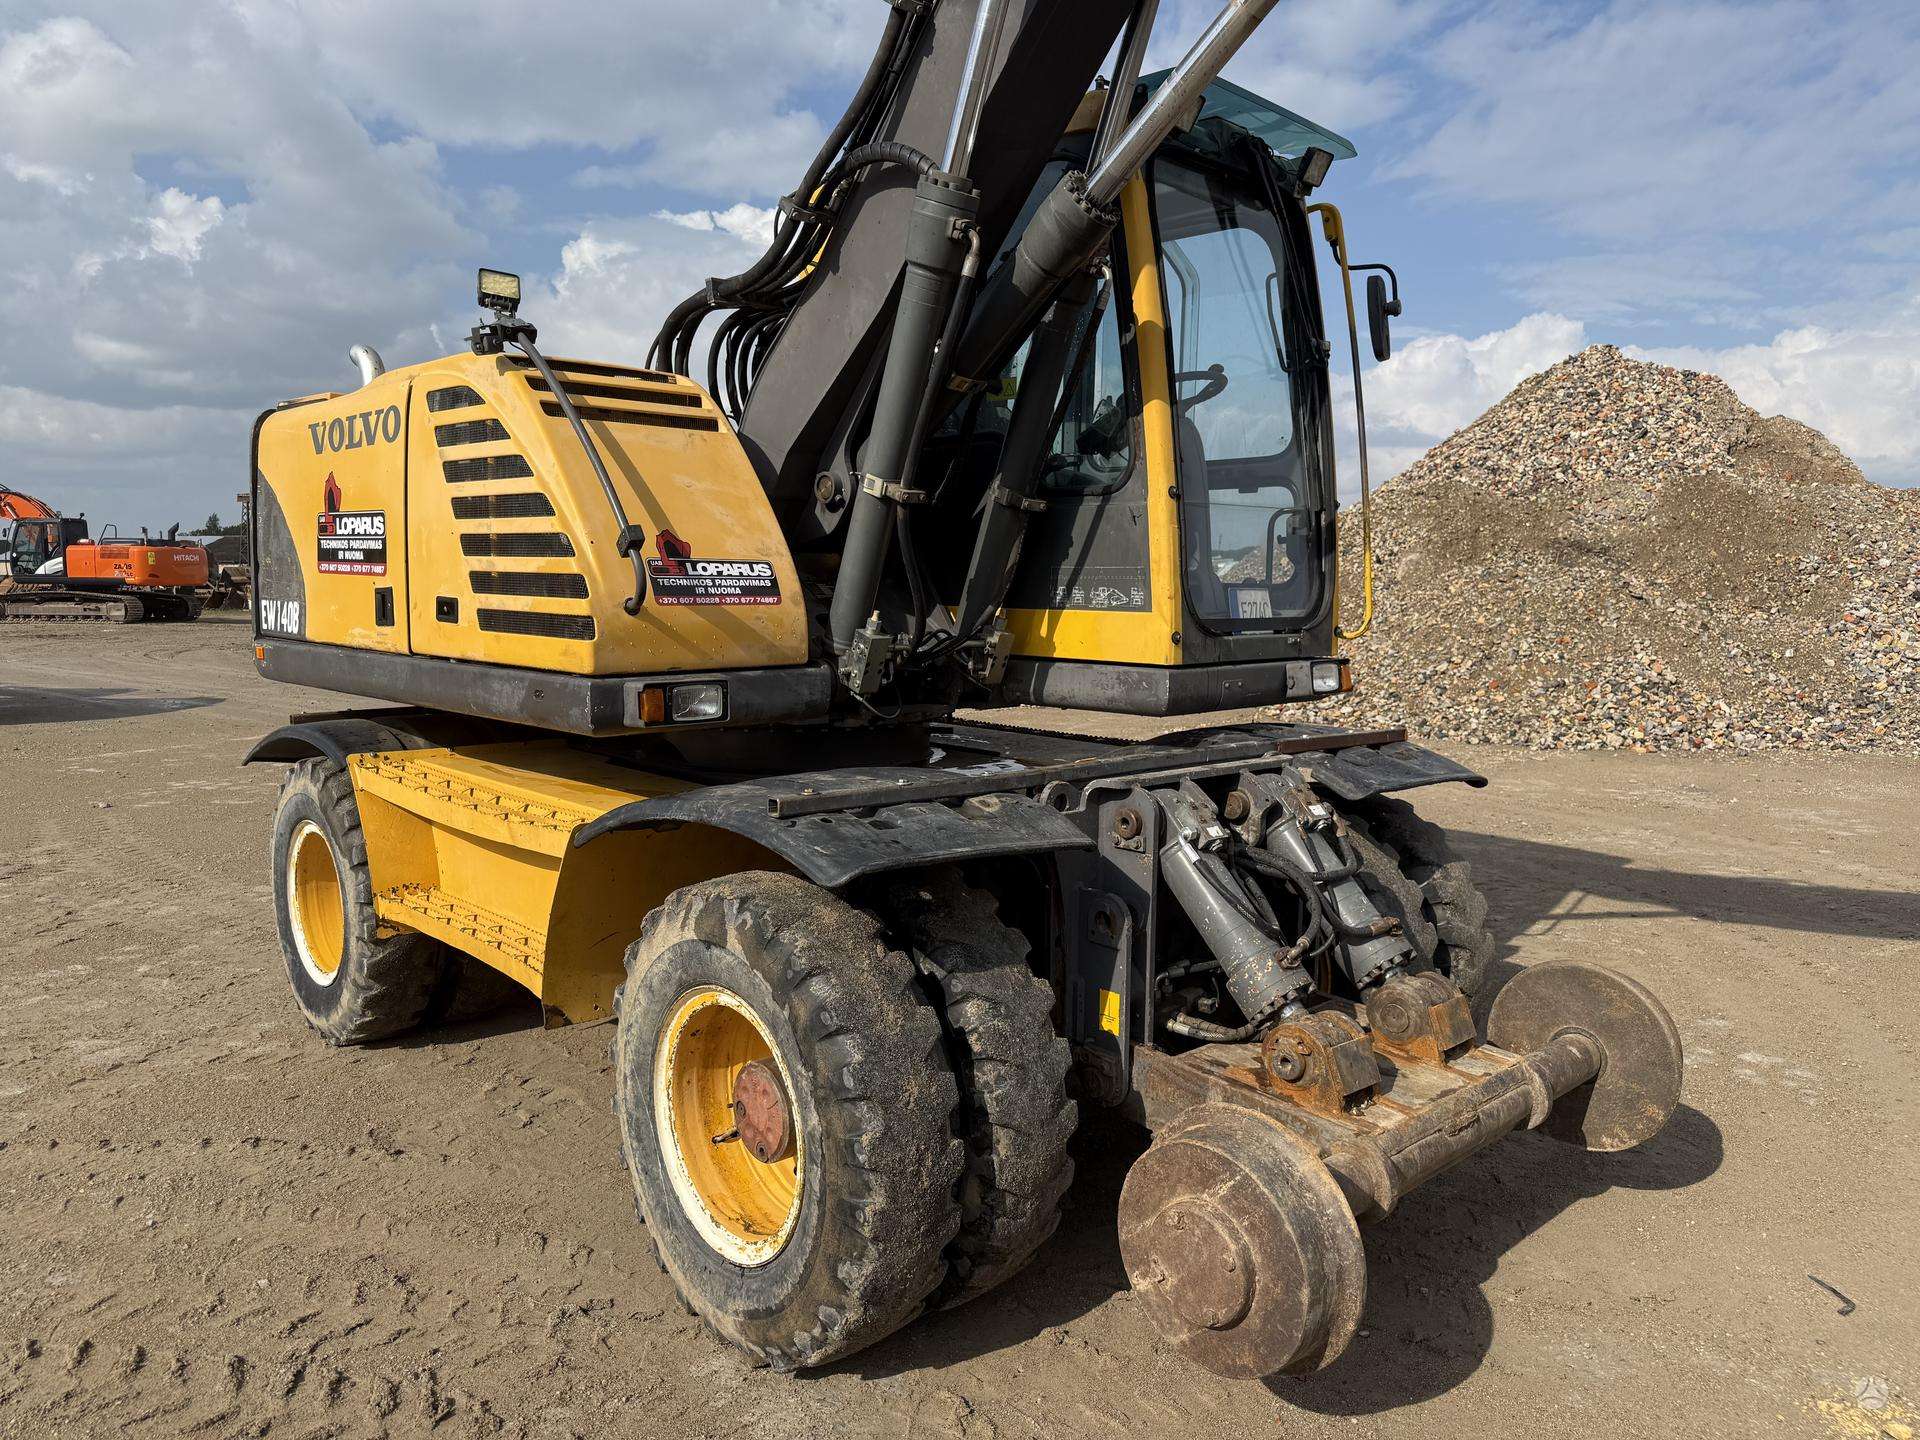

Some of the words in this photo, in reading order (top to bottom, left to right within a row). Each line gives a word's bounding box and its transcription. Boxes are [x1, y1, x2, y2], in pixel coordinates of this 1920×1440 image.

[308, 404, 401, 455] VOLVO
[335, 516, 385, 535] LOPARUS
[320, 539, 349, 549] TECHNIKOS
[349, 539, 383, 550] PARDAVIMAS
[173, 553, 200, 562] HITACHI
[338, 550, 344, 560] IR
[344, 550, 364, 560] NUOMA
[685, 562, 772, 577] LOPARUS
[657, 578, 713, 587] TECHNIKOS
[715, 579, 772, 587] PARDAVIMAS
[707, 587, 742, 595] NUOMA
[261, 600, 300, 635] EW140B
